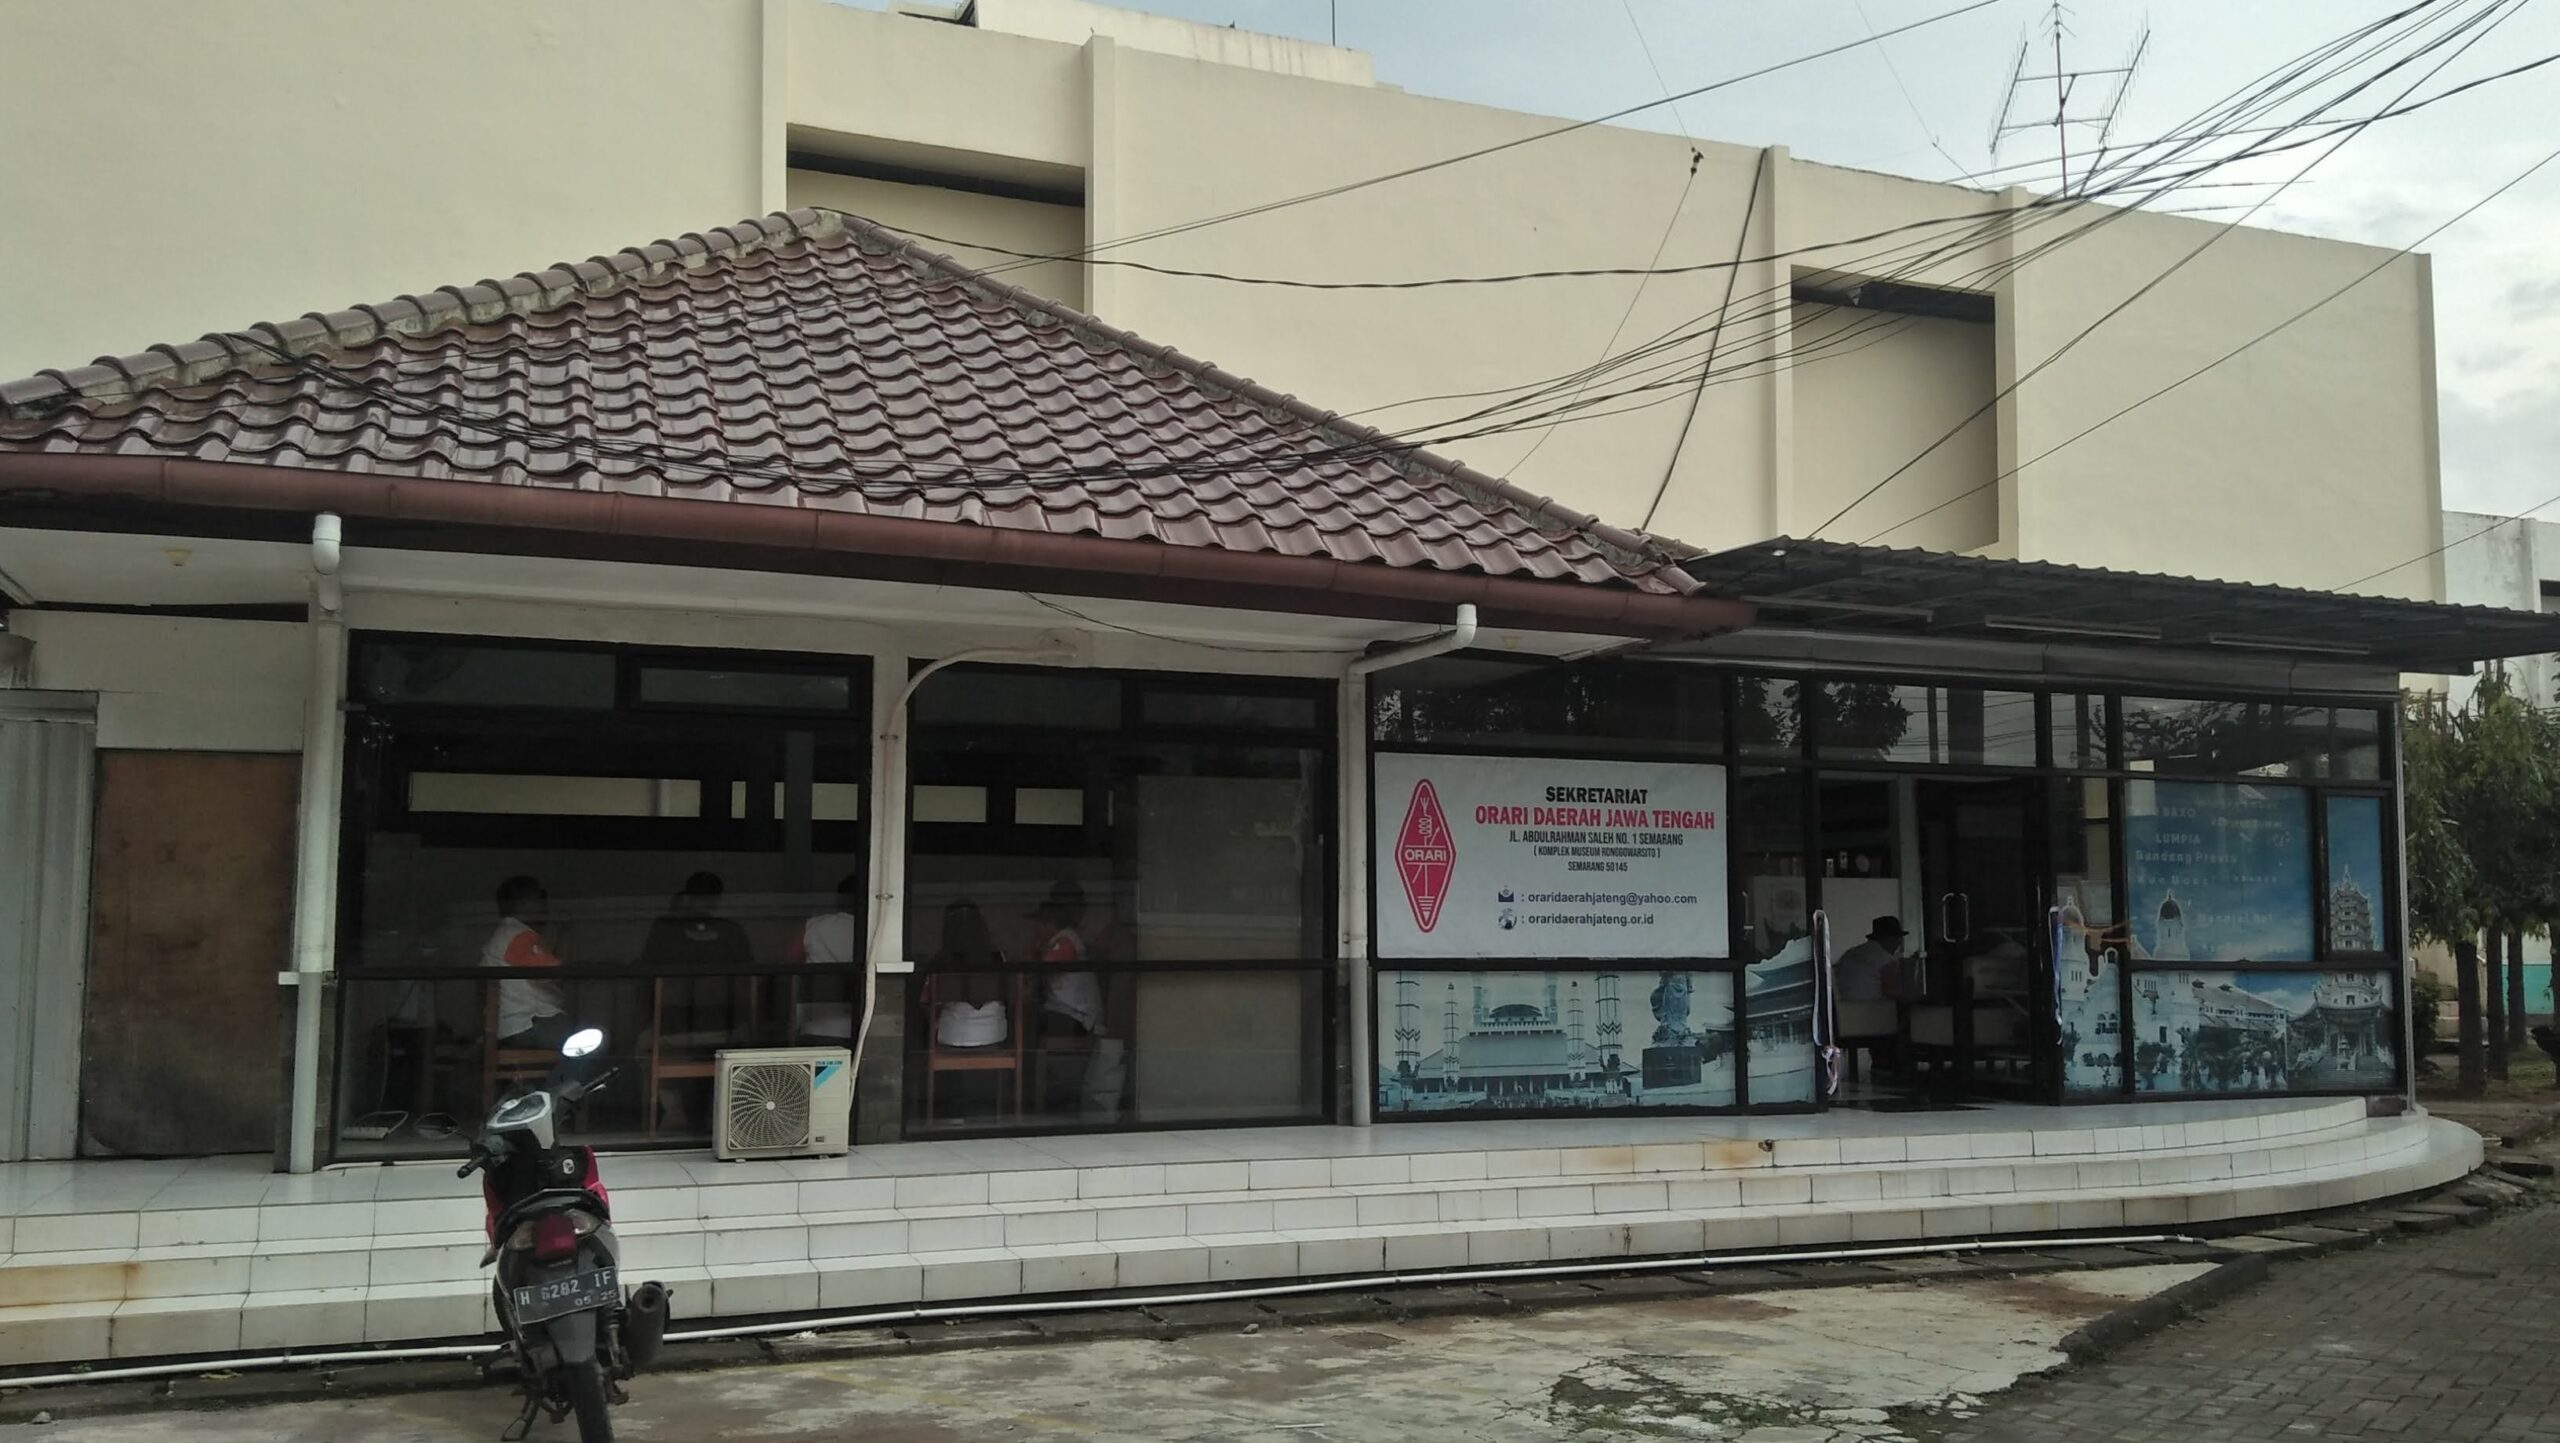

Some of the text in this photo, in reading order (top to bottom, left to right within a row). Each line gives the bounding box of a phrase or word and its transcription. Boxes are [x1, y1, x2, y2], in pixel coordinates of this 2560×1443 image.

[1545, 785, 1649, 805] SEKRETARIAT
[1475, 804, 1715, 830] ORARI DAERAH JAWA TENGAH
[1509, 829, 1684, 846] JL. ABDULRAHMAN SALEH NO. 1 SEMARANG
[2155, 832, 2201, 844] LUMPIA
[1404, 849, 1447, 862] ORARI
[1571, 846, 1601, 857] MUSEUM
[1567, 860, 1629, 872] SEMARANG 50145
[1527, 892, 1698, 906] oraridaerahjateng@yahoo.com
[1527, 913, 1654, 927] oraridaerahjateng.or.id
[519, 1289, 532, 1306] H
